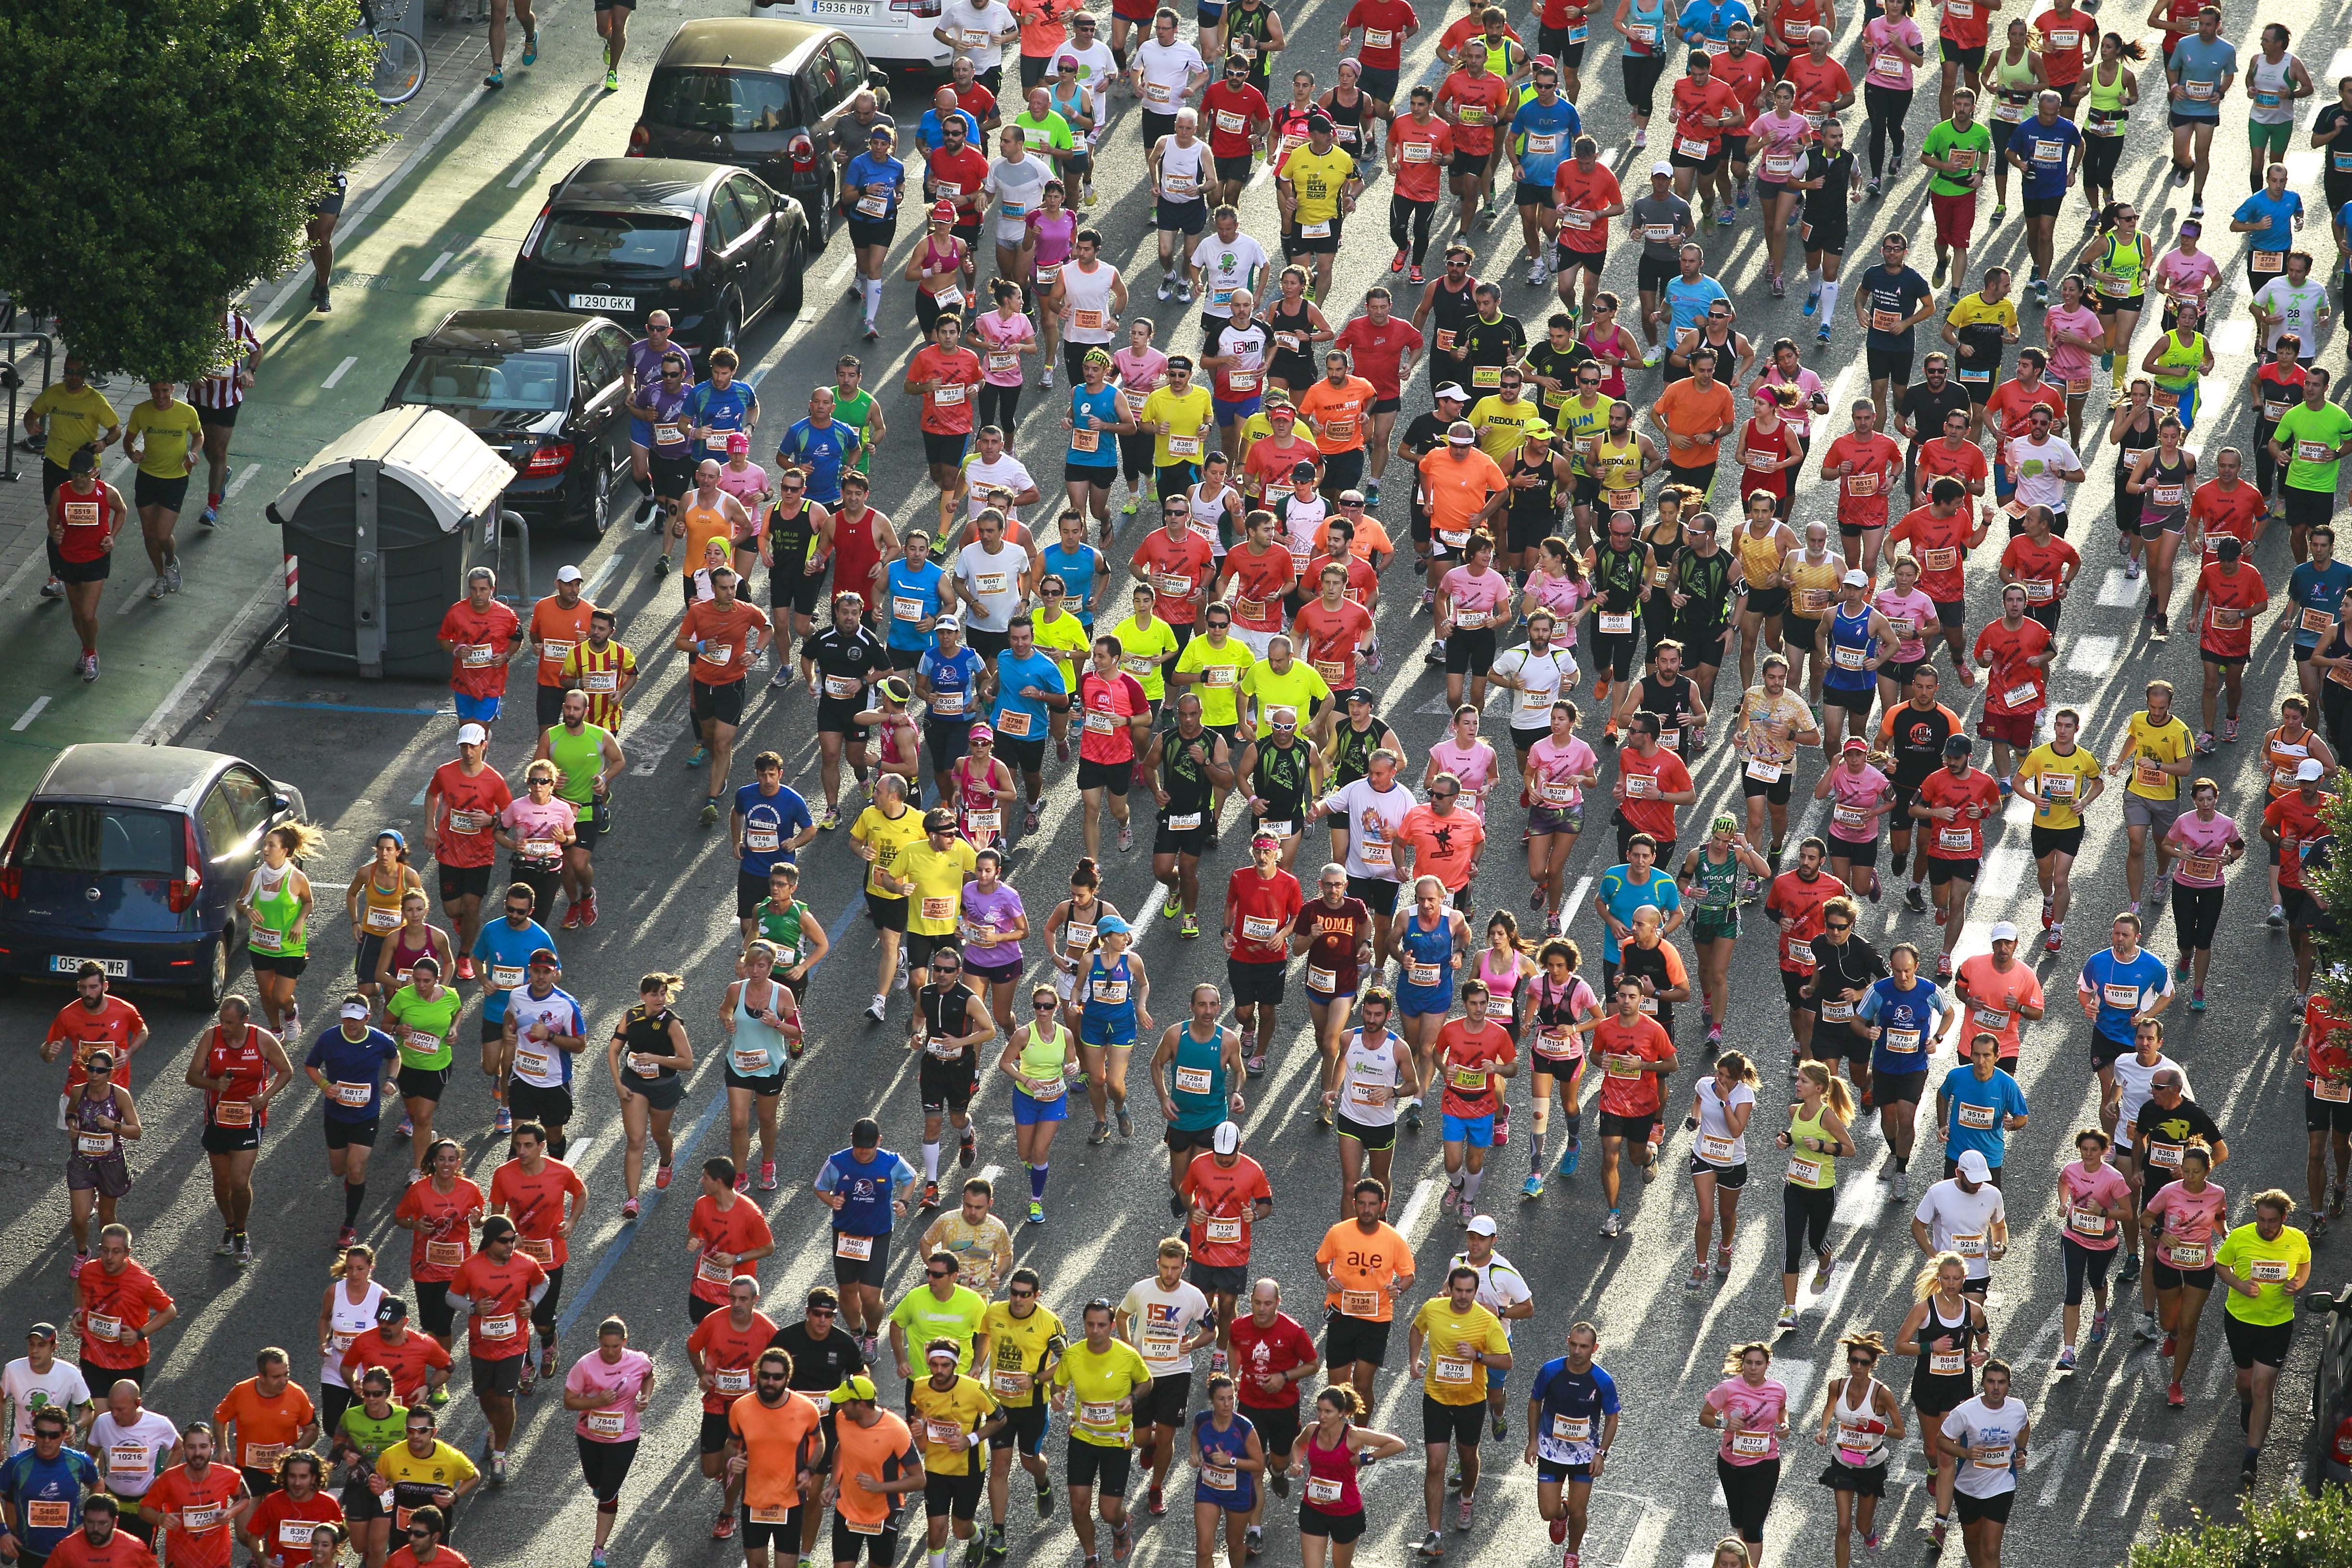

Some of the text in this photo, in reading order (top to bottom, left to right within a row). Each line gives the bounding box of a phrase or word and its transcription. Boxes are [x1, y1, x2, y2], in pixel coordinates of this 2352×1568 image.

[819, 3, 870, 15] 5936 HBX
[578, 296, 632, 310] 1290 GKK
[1757, 763, 1774, 772] 6973
[749, 820, 777, 830] FINISHER
[374, 914, 395, 922] 10068
[256, 932, 275, 941] 10115
[1795, 945, 1810, 954] 9113
[1313, 973, 1327, 982] 7396
[1984, 1012, 2001, 1022] 8772
[1983, 1019, 2000, 1027] PIETRO
[413, 1033, 434, 1042] 10001
[523, 1057, 539, 1066] 8709
[1968, 1110, 1985, 1118] 9514
[1963, 1116, 1989, 1125] SALVADOR
[1710, 1142, 1727, 1151] 8689
[1795, 1164, 1812, 1174] 7473
[846, 1239, 863, 1247] 9480
[706, 1264, 726, 1274] 10009
[1146, 1303, 1180, 1322] 15K
[1210, 1471, 1227, 1480] 8752
[1316, 1485, 1332, 1494] 7926
